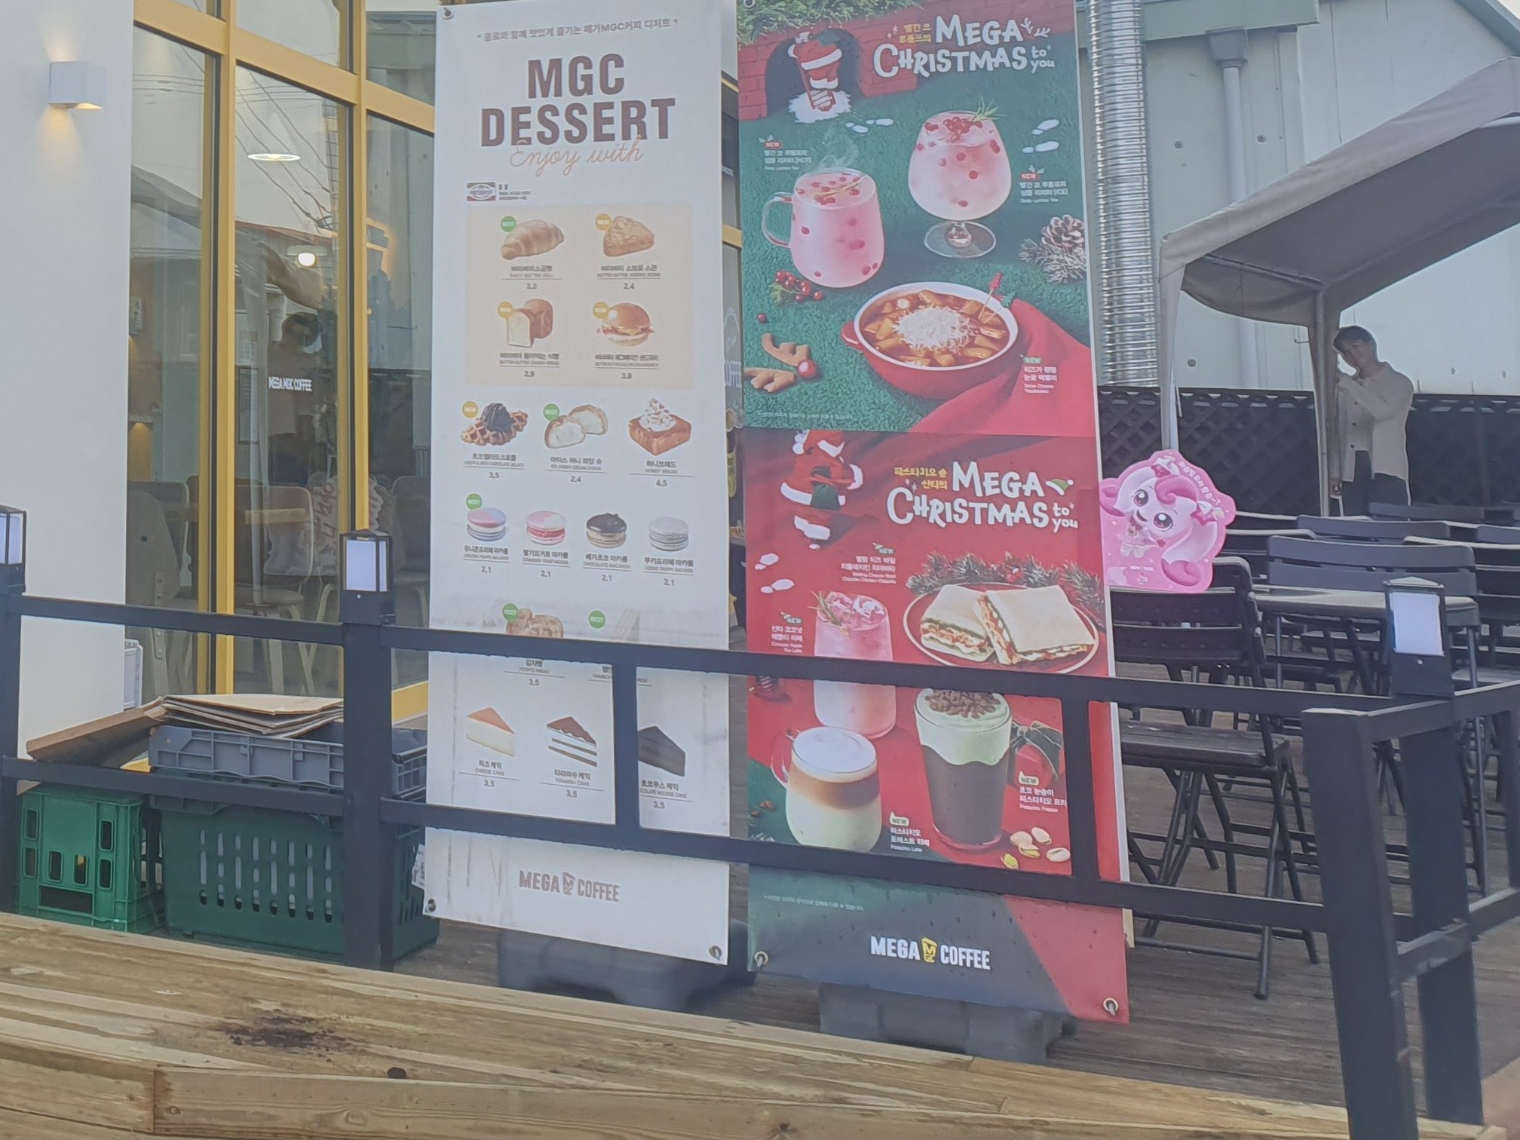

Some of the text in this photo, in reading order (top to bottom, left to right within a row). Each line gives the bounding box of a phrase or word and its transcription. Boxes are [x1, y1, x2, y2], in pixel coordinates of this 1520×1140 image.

[556, 26, 582, 37] 즐기는
[584, 21, 642, 34] 메가MGC커피
[1031, 45, 1047, 58] to
[1030, 59, 1056, 74] you
[528, 53, 625, 99] MGC
[481, 98, 676, 147] DESSERT
[510, 134, 644, 176] Enjoy with
[655, 479, 668, 487] 4.5
[1052, 502, 1069, 517] to
[1051, 518, 1078, 534] you
[481, 565, 491, 573] 2.1
[541, 570, 551, 578] 2.1
[601, 574, 612, 582] 2.1
[663, 578, 675, 586] 2.1
[483, 780, 495, 788] 3.5
[566, 789, 578, 798] 3.5
[653, 800, 665, 809] 3.5
[1019, 795, 1052, 804] 피스타치오
[890, 827, 922, 836] 피스타치오
[519, 870, 620, 902] MEGA COFFEE
[871, 935, 991, 970] MEGA COFFEE
